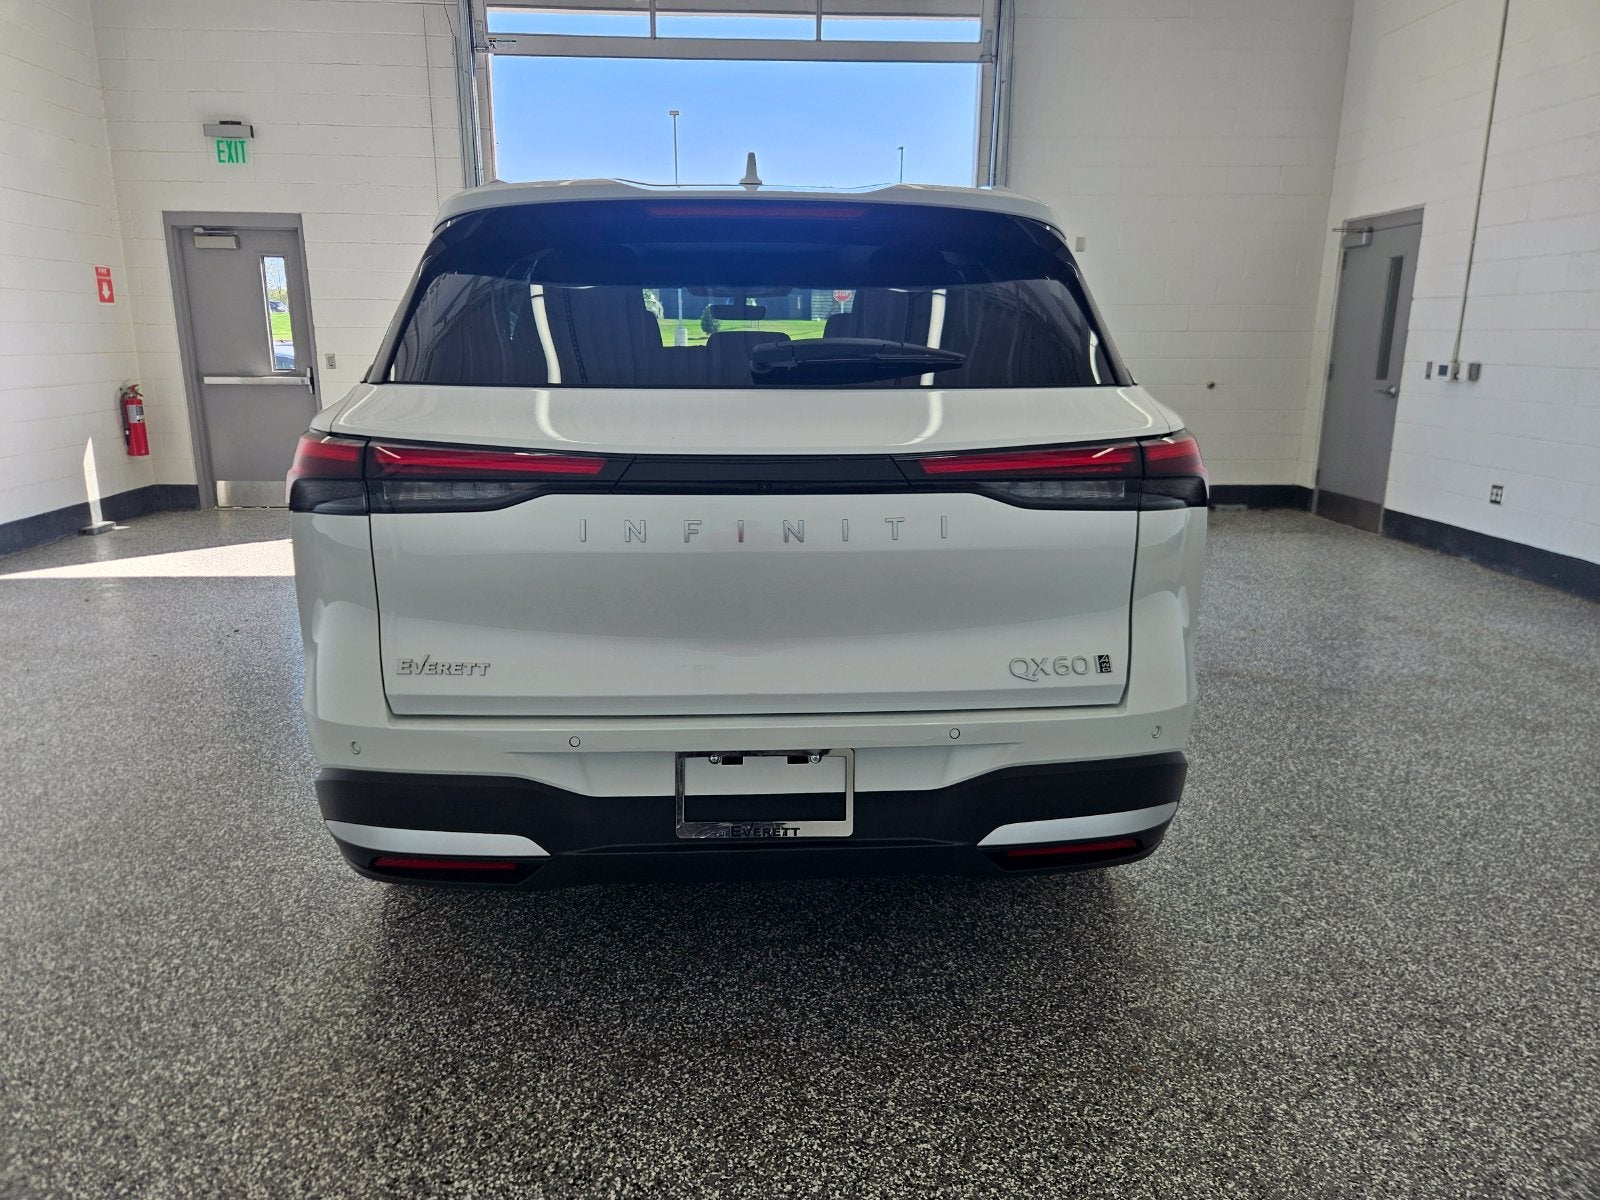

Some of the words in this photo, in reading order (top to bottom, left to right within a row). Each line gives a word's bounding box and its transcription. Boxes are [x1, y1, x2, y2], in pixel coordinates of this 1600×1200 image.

[216, 140, 246, 164] EXIT
[579, 515, 948, 543] INFINITI
[396, 654, 490, 676] EVERETT
[1009, 656, 1088, 682] QX60
[731, 824, 801, 838] EVERETT
